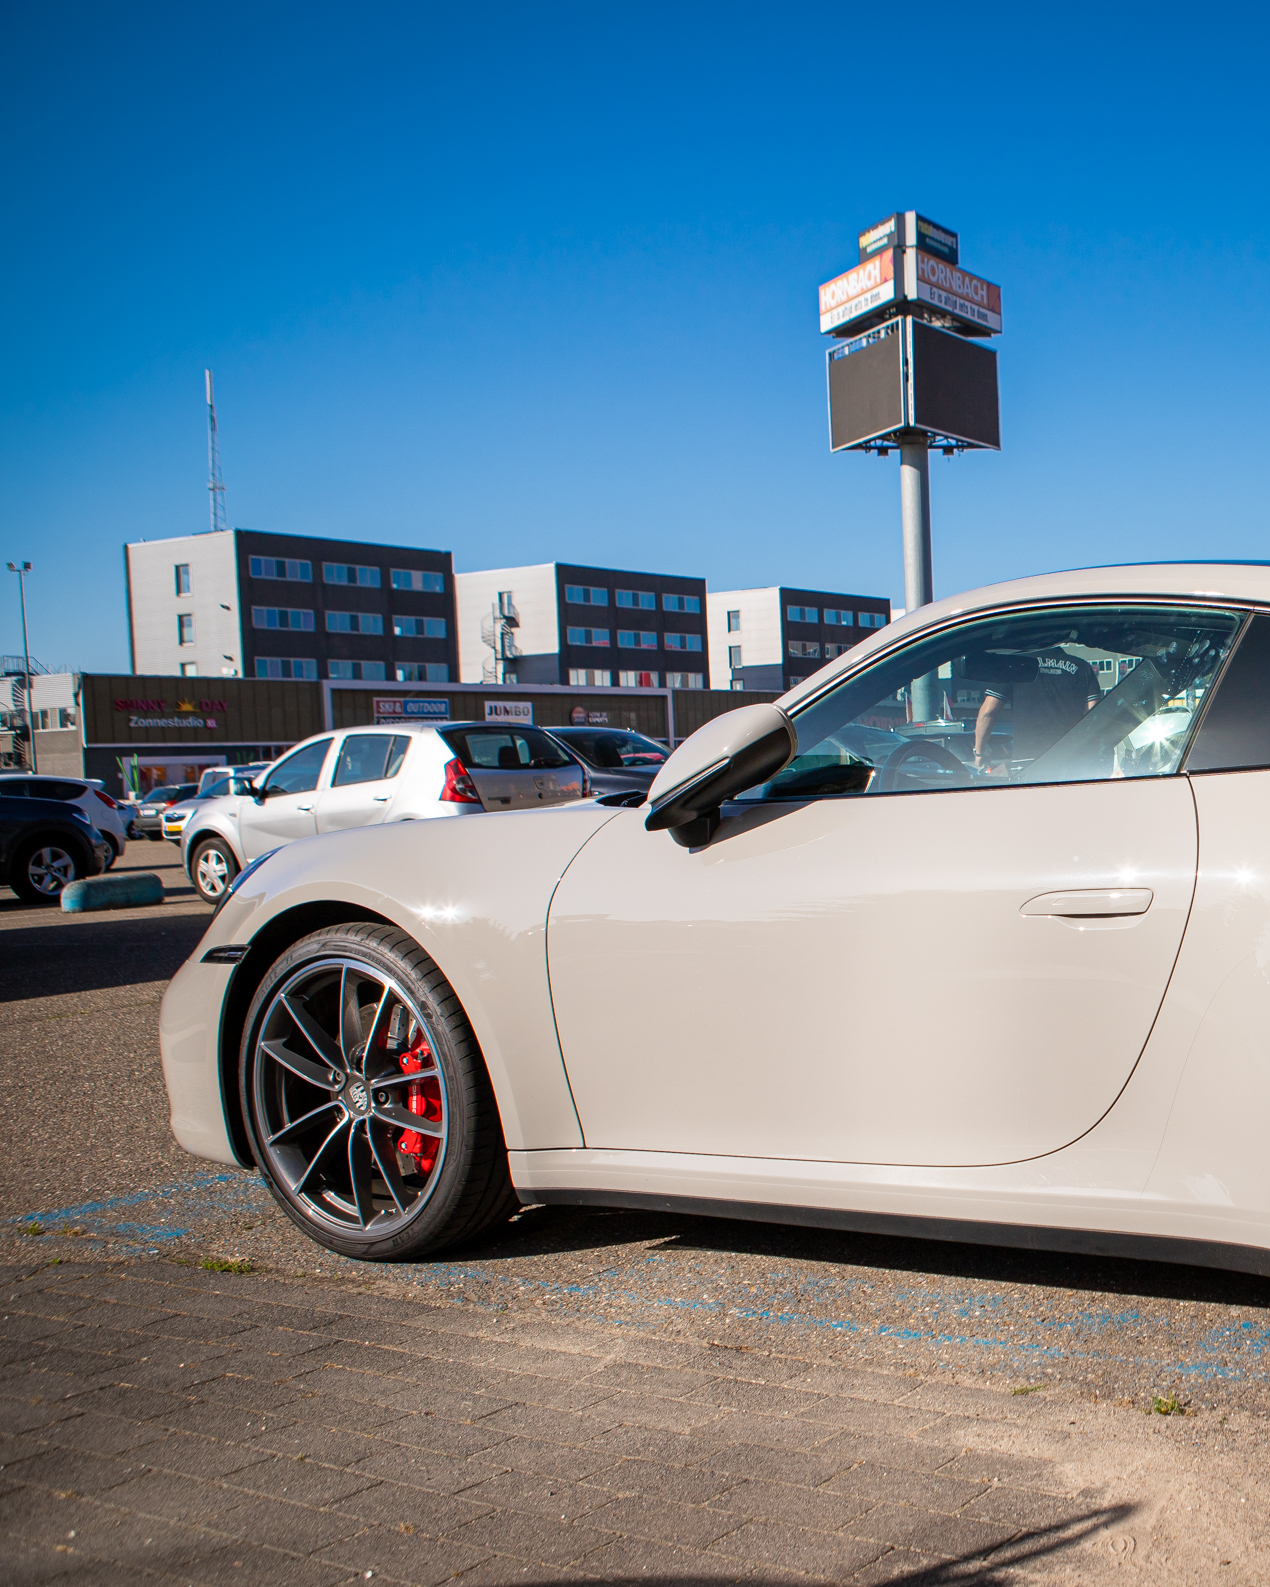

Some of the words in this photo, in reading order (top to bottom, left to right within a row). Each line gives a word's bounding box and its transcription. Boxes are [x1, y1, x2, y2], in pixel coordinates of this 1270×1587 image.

[820, 259, 881, 312] HORNBACH
[917, 254, 988, 305] HORNBACH
[115, 698, 167, 711] SUNNY
[201, 699, 228, 711] DAY
[378, 701, 394, 713] SKI
[395, 702, 402, 713] &
[406, 702, 446, 713] OUTDOOR
[487, 705, 531, 717] JUMBO
[128, 715, 206, 728] Zonnestudio
